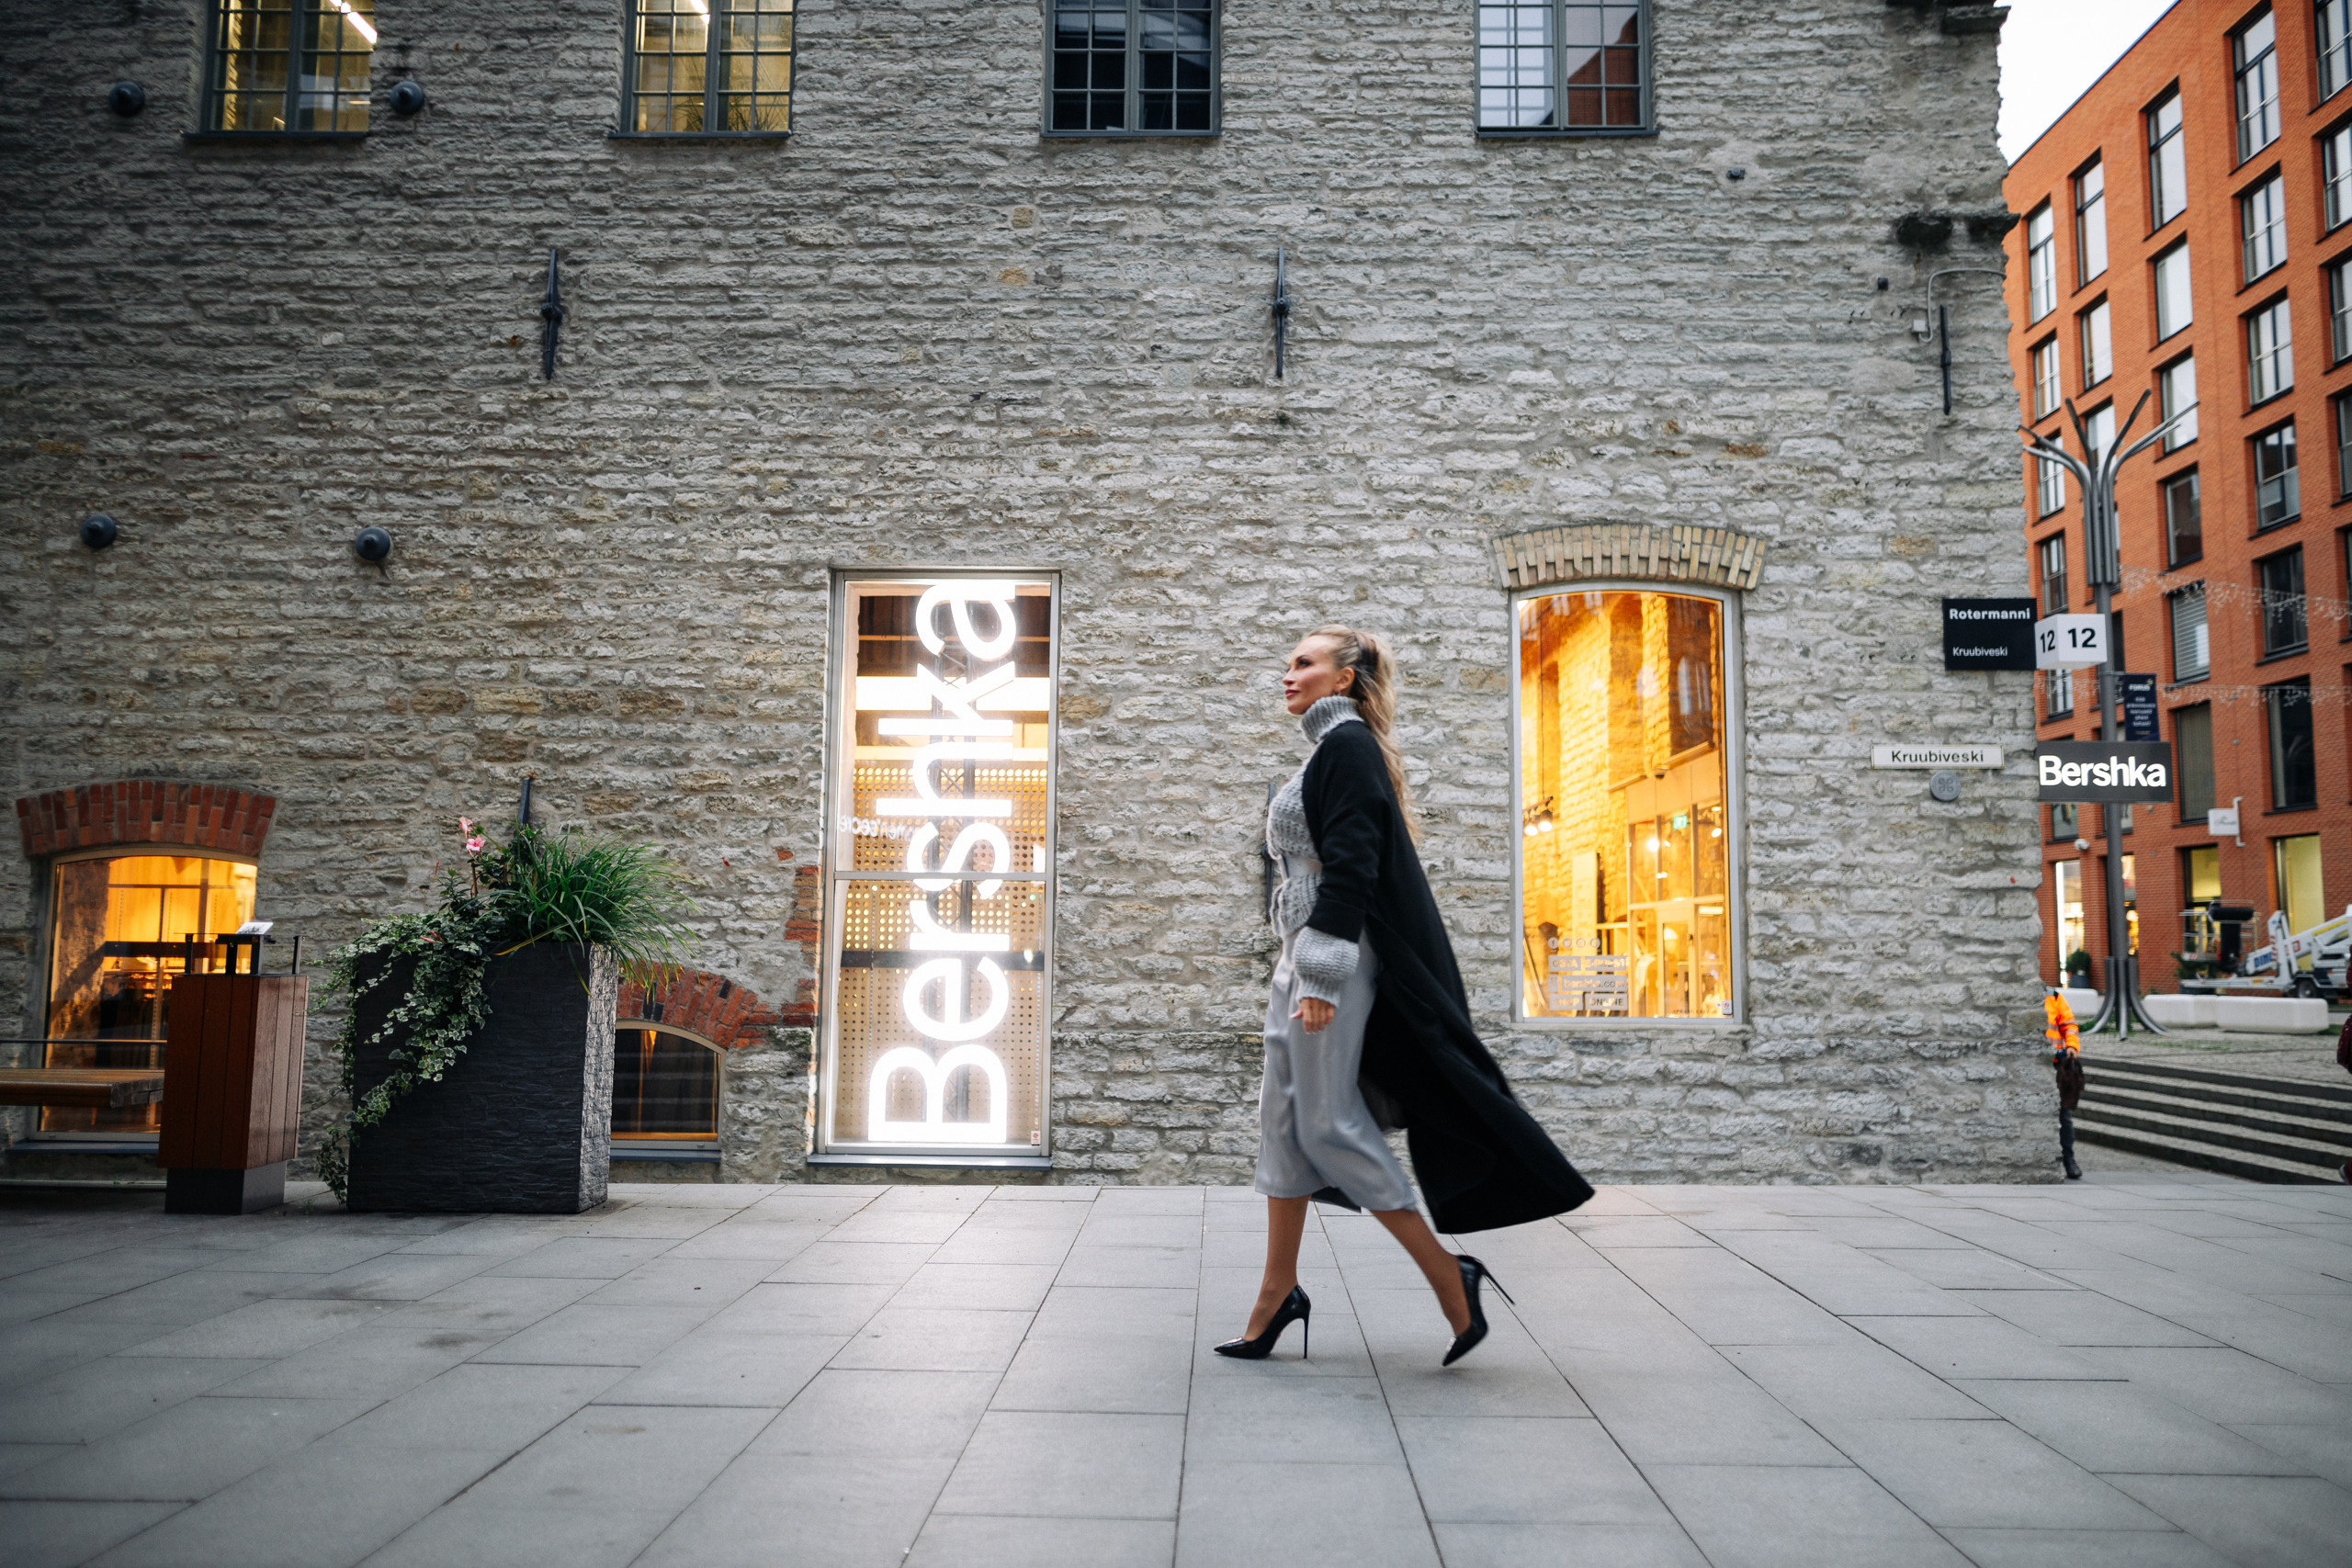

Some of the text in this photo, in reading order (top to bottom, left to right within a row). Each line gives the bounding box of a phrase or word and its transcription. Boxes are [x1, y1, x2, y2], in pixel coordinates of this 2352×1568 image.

[1949, 607, 2030, 620] Rotermanni
[2040, 629, 2056, 654] 12
[2067, 627, 2098, 649] 12
[1952, 646, 2008, 657] Kruubiveski
[1891, 750, 1984, 763] Kruubiveski
[2039, 755, 2166, 787] Bershka
[868, 580, 1016, 1143] Bershka
[1554, 998, 1623, 1007] SHOP ONLINE
